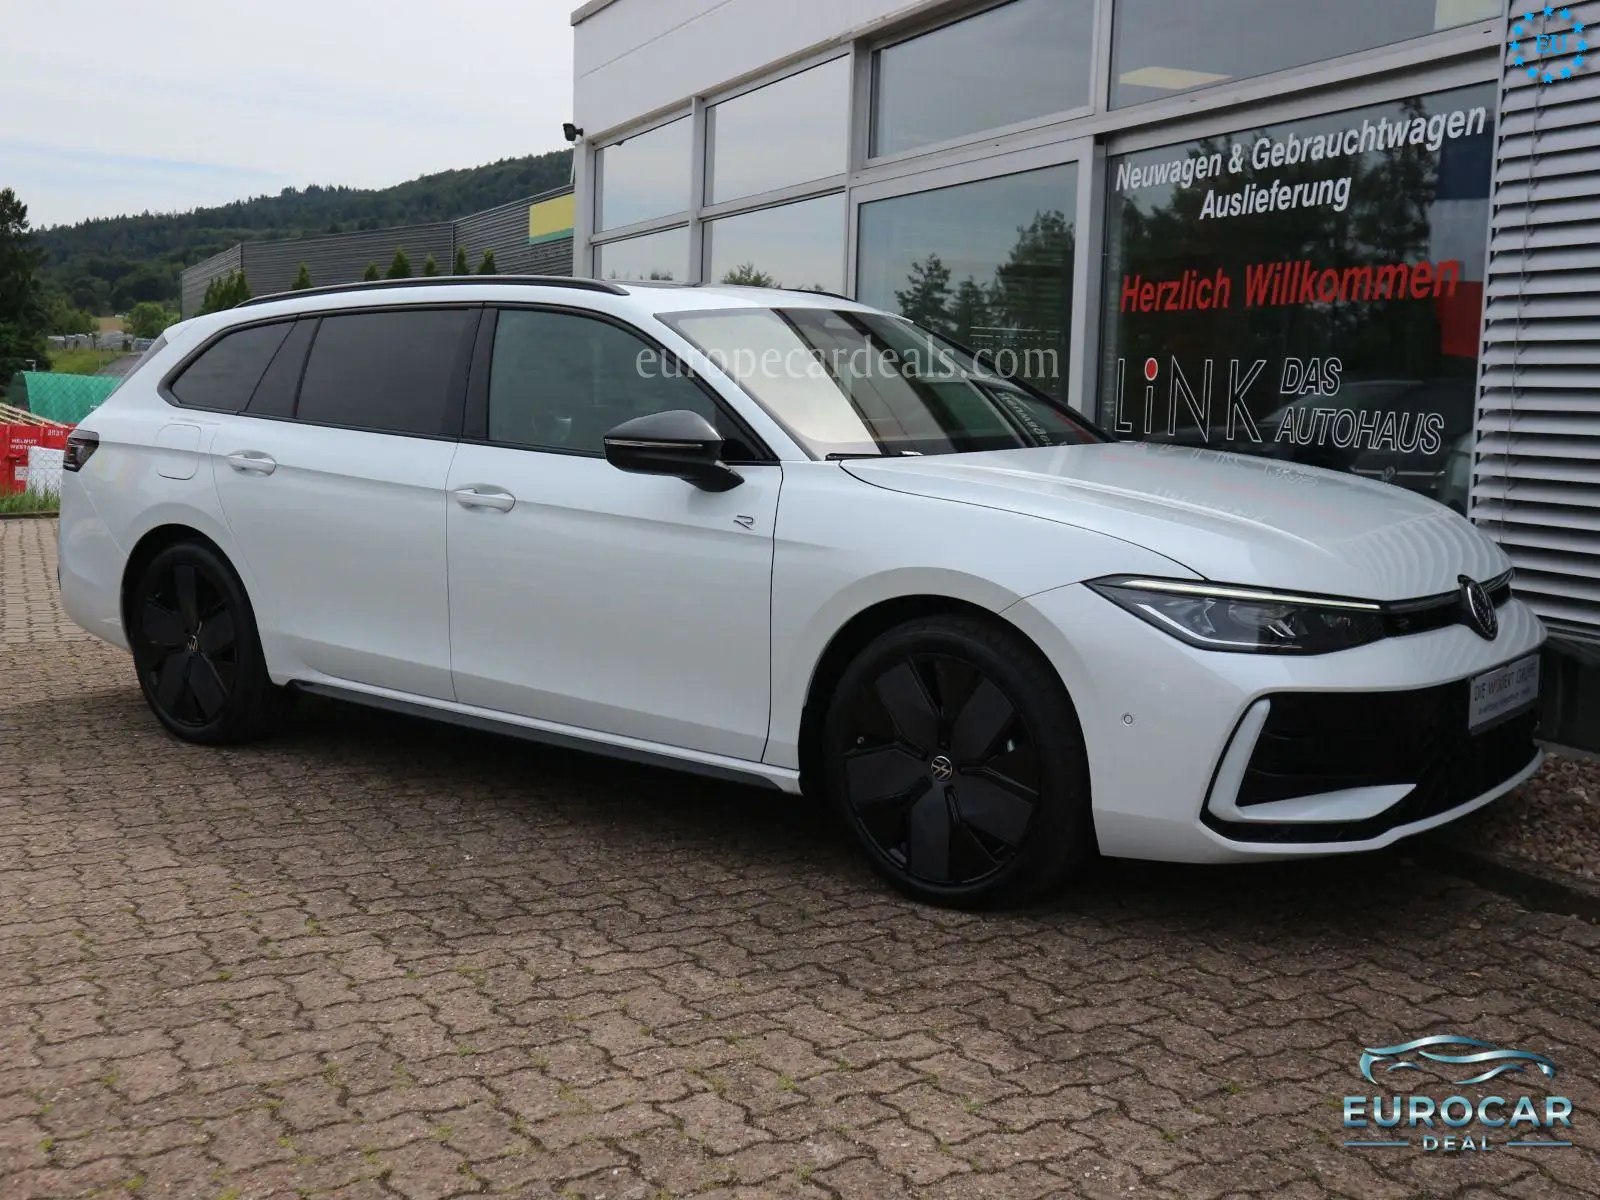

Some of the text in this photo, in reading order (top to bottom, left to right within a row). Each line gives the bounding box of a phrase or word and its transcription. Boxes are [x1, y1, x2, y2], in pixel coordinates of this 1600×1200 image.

[1116, 106, 1486, 191] Neuwagen & Gebrauchtwagen
[1199, 175, 1352, 220] Auslieferung
[1120, 259, 1459, 314] Herzlich Willkommen
[1281, 357, 1343, 396] DAS
[1275, 407, 1444, 454] AUTOHAUS
